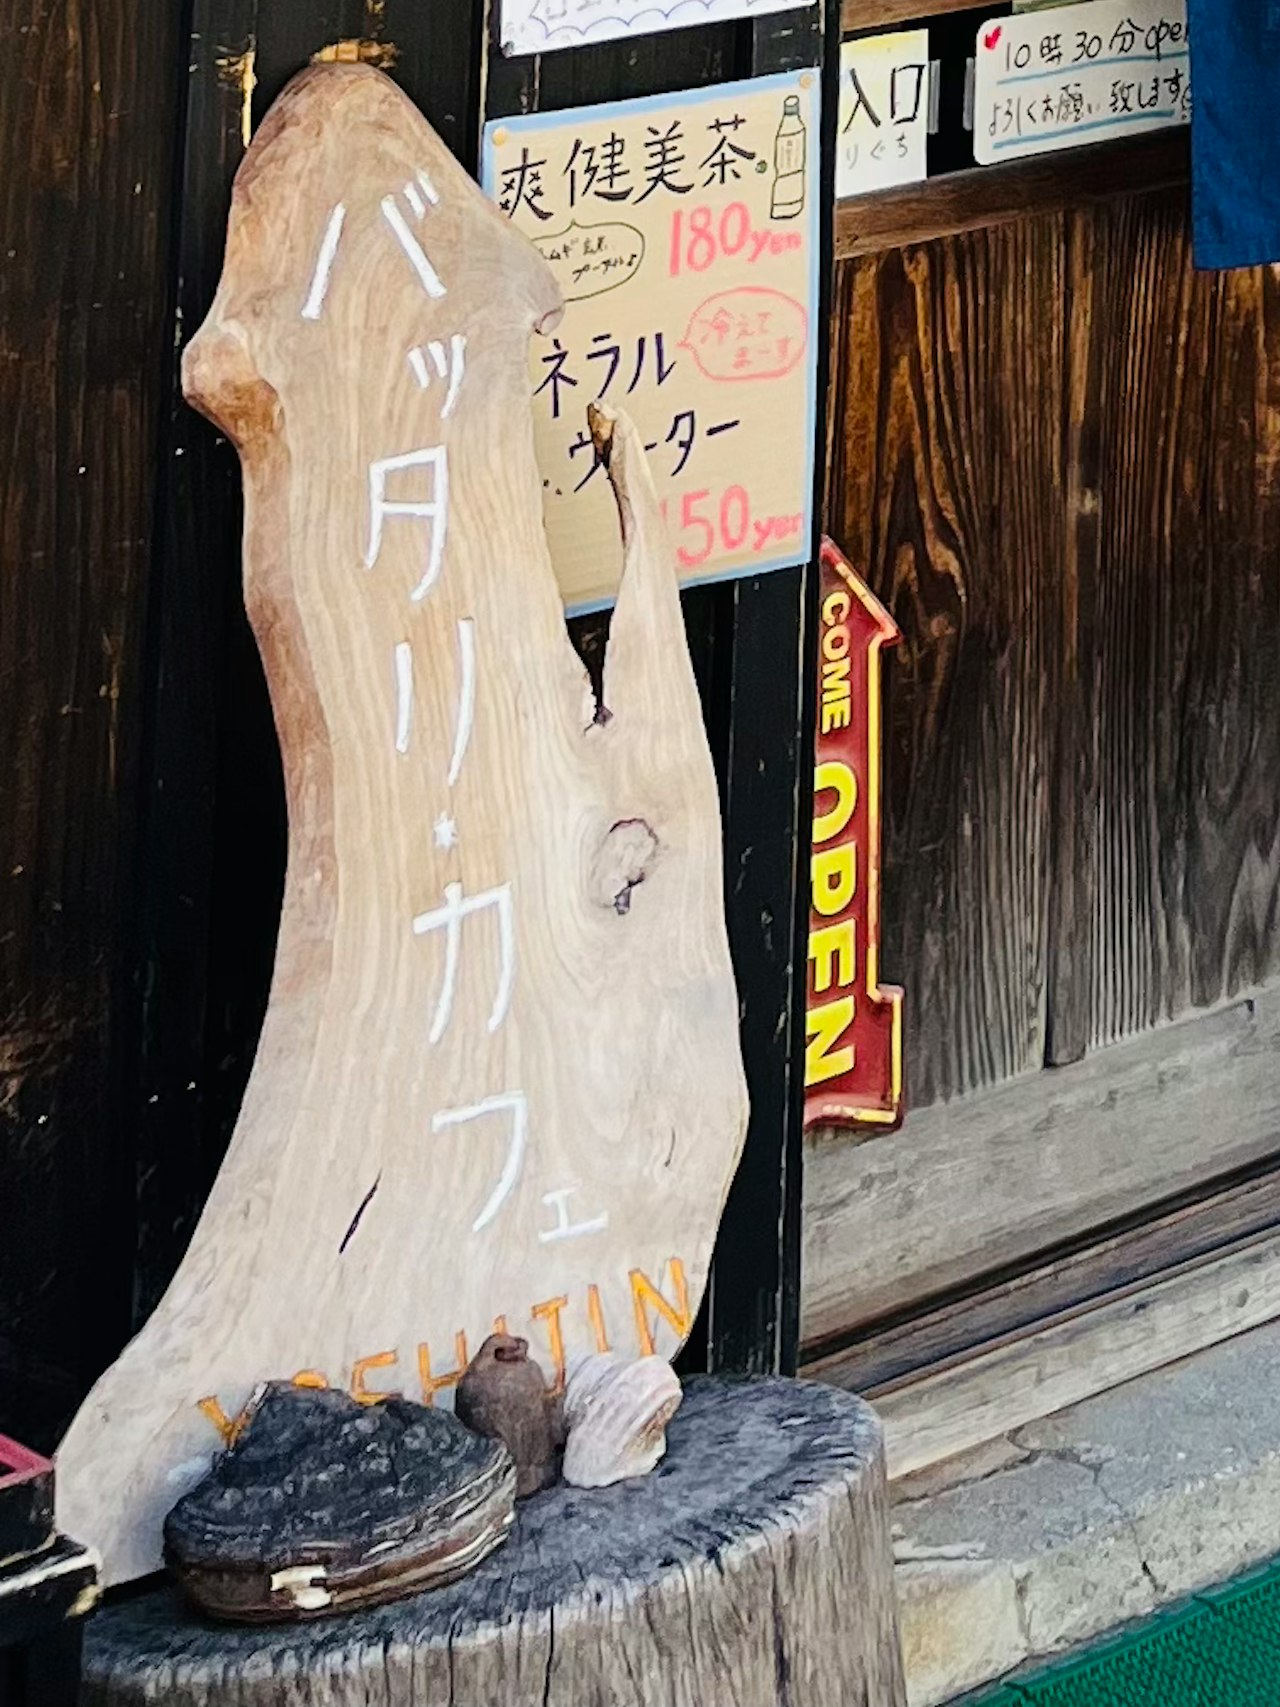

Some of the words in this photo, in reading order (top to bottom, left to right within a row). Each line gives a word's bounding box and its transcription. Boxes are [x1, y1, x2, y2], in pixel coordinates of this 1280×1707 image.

[843, 65, 925, 134] 入口
[500, 112, 756, 221] 爽健美茶
[821, 590, 851, 734] COME
[804, 760, 859, 1087] OPEN
